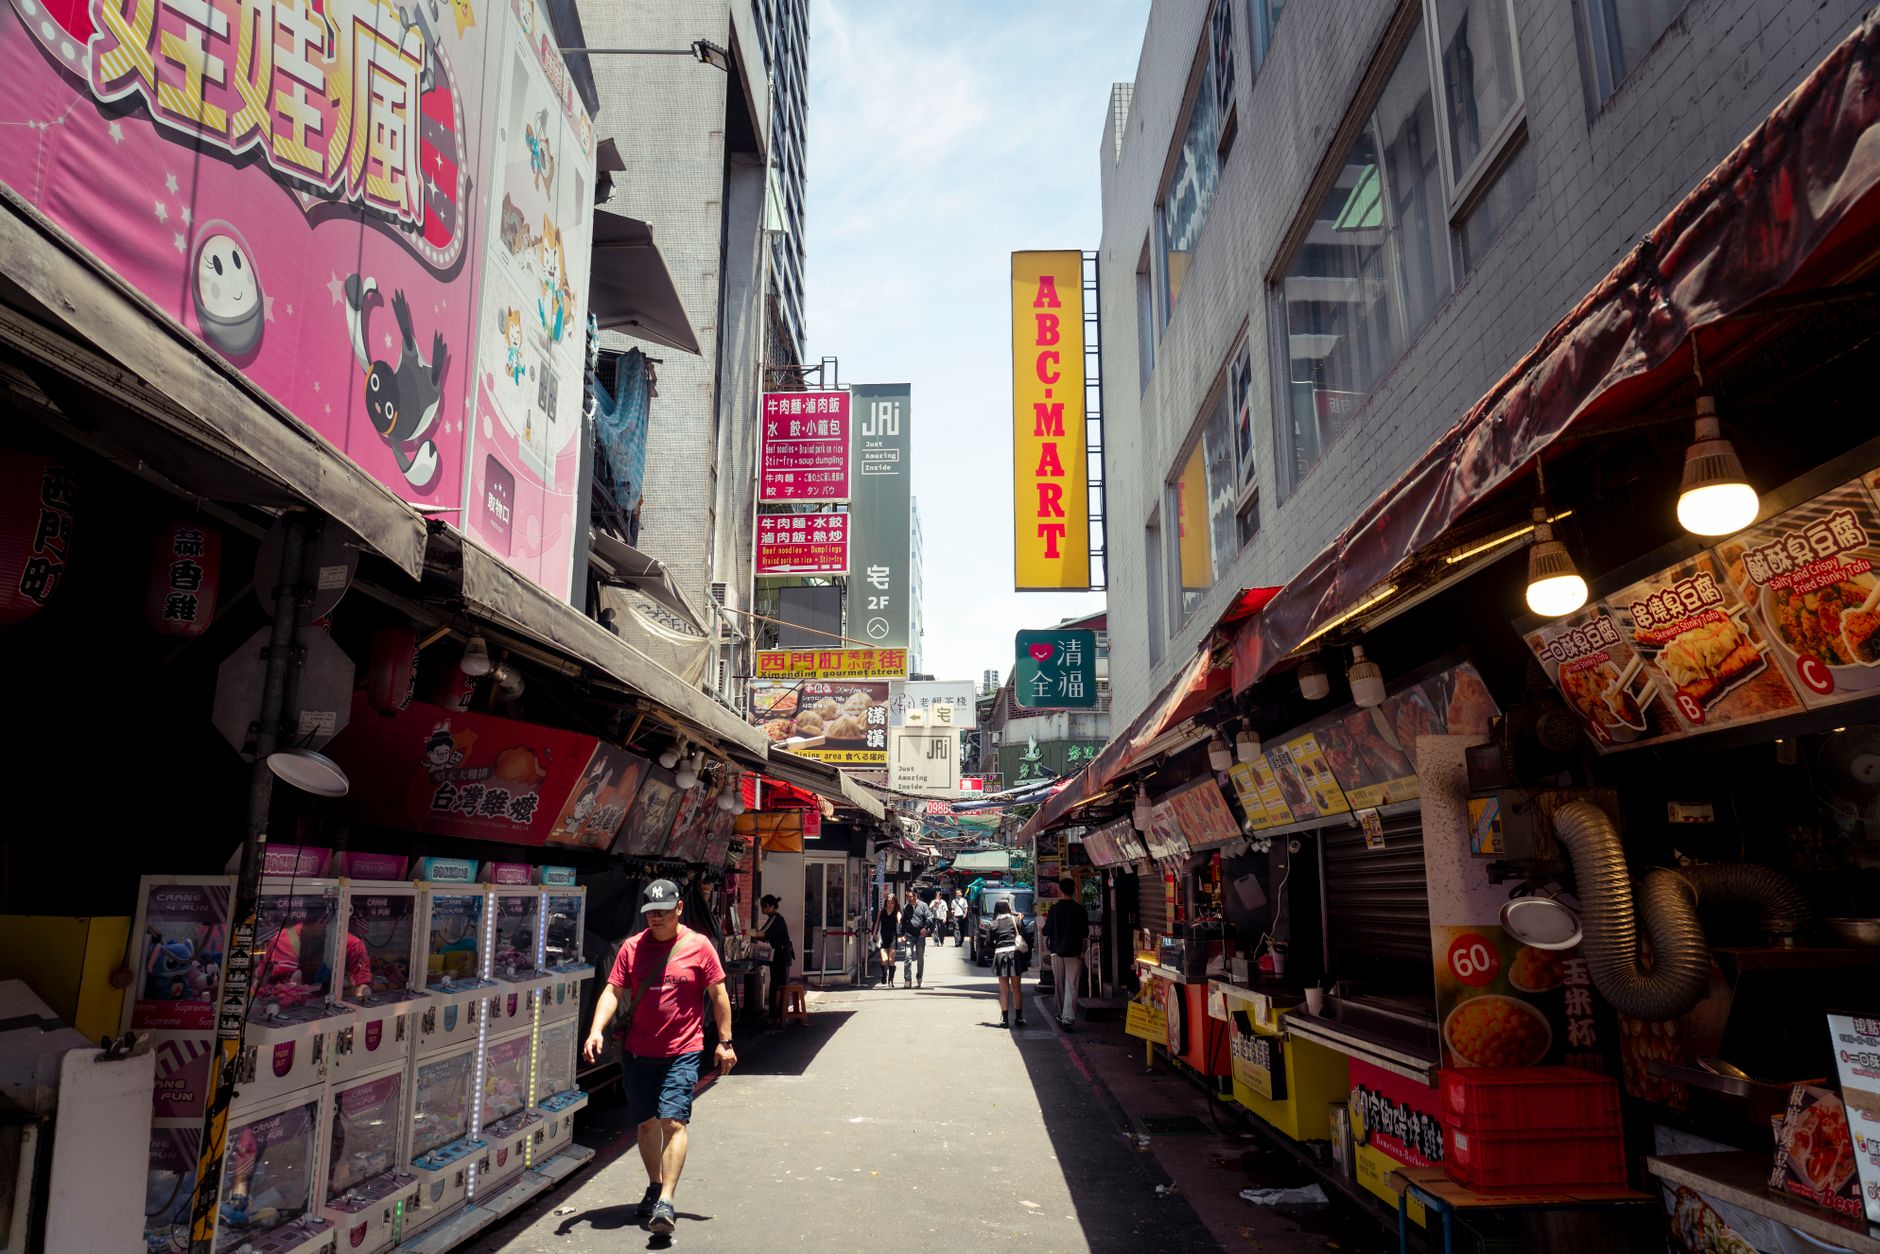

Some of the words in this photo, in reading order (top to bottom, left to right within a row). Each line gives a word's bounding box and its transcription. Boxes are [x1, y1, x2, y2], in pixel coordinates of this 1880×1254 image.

[1033, 276, 1066, 559] ABC-MART
[833, 444, 843, 453] rice
[765, 456, 793, 467] Stir-fry
[799, 457, 814, 465] soup
[816, 454, 843, 466] dumpling
[487, 492, 510, 526] 取物口
[763, 546, 776, 555] Beef
[778, 546, 802, 554] noodles
[811, 545, 842, 554] Dumplings
[801, 556, 812, 564] rice
[820, 555, 842, 564] Stir-fry
[867, 565, 889, 589] 宅
[1769, 573, 1792, 591] Salty
[1792, 568, 1807, 582] and
[1808, 558, 1839, 577] Crispy
[1793, 581, 1814, 596] Fried
[1814, 570, 1848, 588] Stinky
[1847, 559, 1872, 577] Tofu
[867, 596, 889, 610] 2F
[1631, 573, 1723, 629] 串燒臭豆腐
[1654, 622, 1682, 640] Skewers
[1680, 616, 1704, 634] Stinky
[1701, 611, 1720, 626] Tofu
[1540, 615, 1621, 662] 一口酥臭豆腐
[1057, 639, 1082, 667] 清
[1568, 661, 1580, 673] Fried
[1579, 657, 1597, 670] Stinky
[1596, 652, 1610, 665] Tofu
[760, 671, 817, 679] Ximending
[823, 669, 869, 677] gourmet
[1803, 661, 1828, 689] C
[1679, 696, 1701, 720] B
[1591, 720, 1611, 742] A
[156, 894, 202, 902] CRANE
[180, 904, 209, 913] FUN
[1452, 943, 1490, 977] 60
[173, 1002, 212, 1013] Supreme
[161, 1092, 194, 1101] FUN
[252, 1118, 281, 1134] CRANE
[1823, 1183, 1862, 1217] Best
